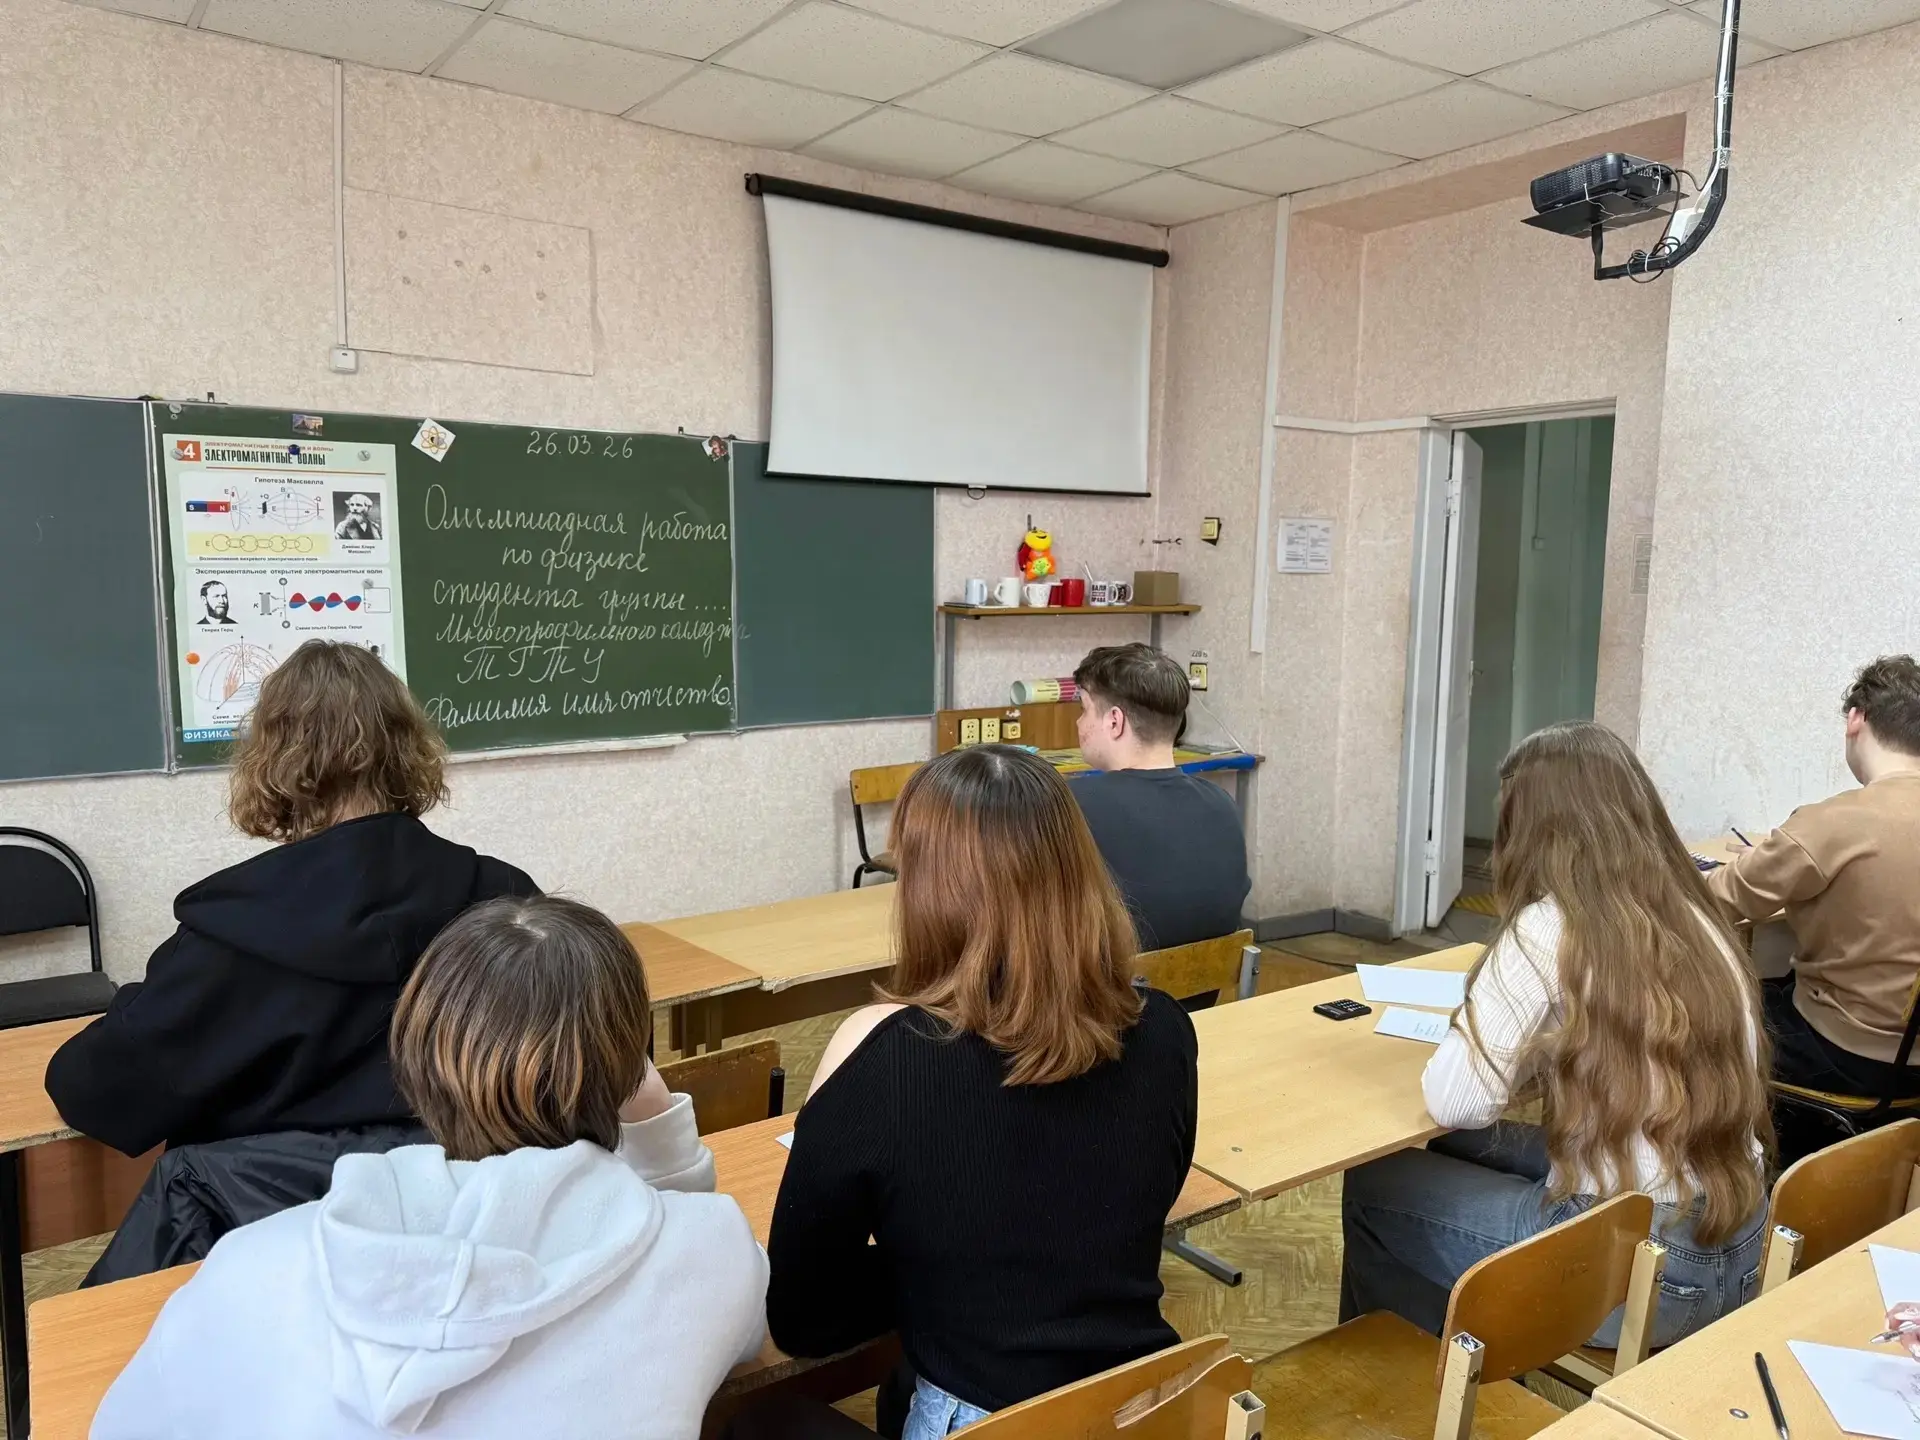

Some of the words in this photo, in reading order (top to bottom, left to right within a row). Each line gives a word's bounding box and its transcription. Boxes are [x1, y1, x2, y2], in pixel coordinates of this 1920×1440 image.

[183, 443, 196, 459] 4
[204, 449, 293, 465] ЭЛЕКТРОМАГНИТНЫЕ
[297, 452, 326, 466] ВОЛНЫ
[255, 477, 286, 485] Гипотеза
[286, 478, 324, 486] Максвелла
[219, 504, 226, 512] N
[425, 484, 628, 552] Олимпиадная
[640, 511, 728, 555] работа
[502, 547, 533, 565] по
[541, 548, 649, 586] физике
[433, 579, 584, 628] студента
[599, 590, 686, 625] группы
[436, 613, 656, 656] Многопрофильного
[423, 693, 551, 729] Фамилия
[562, 691, 618, 715] имя
[183, 730, 231, 739] ФИЗИКА
